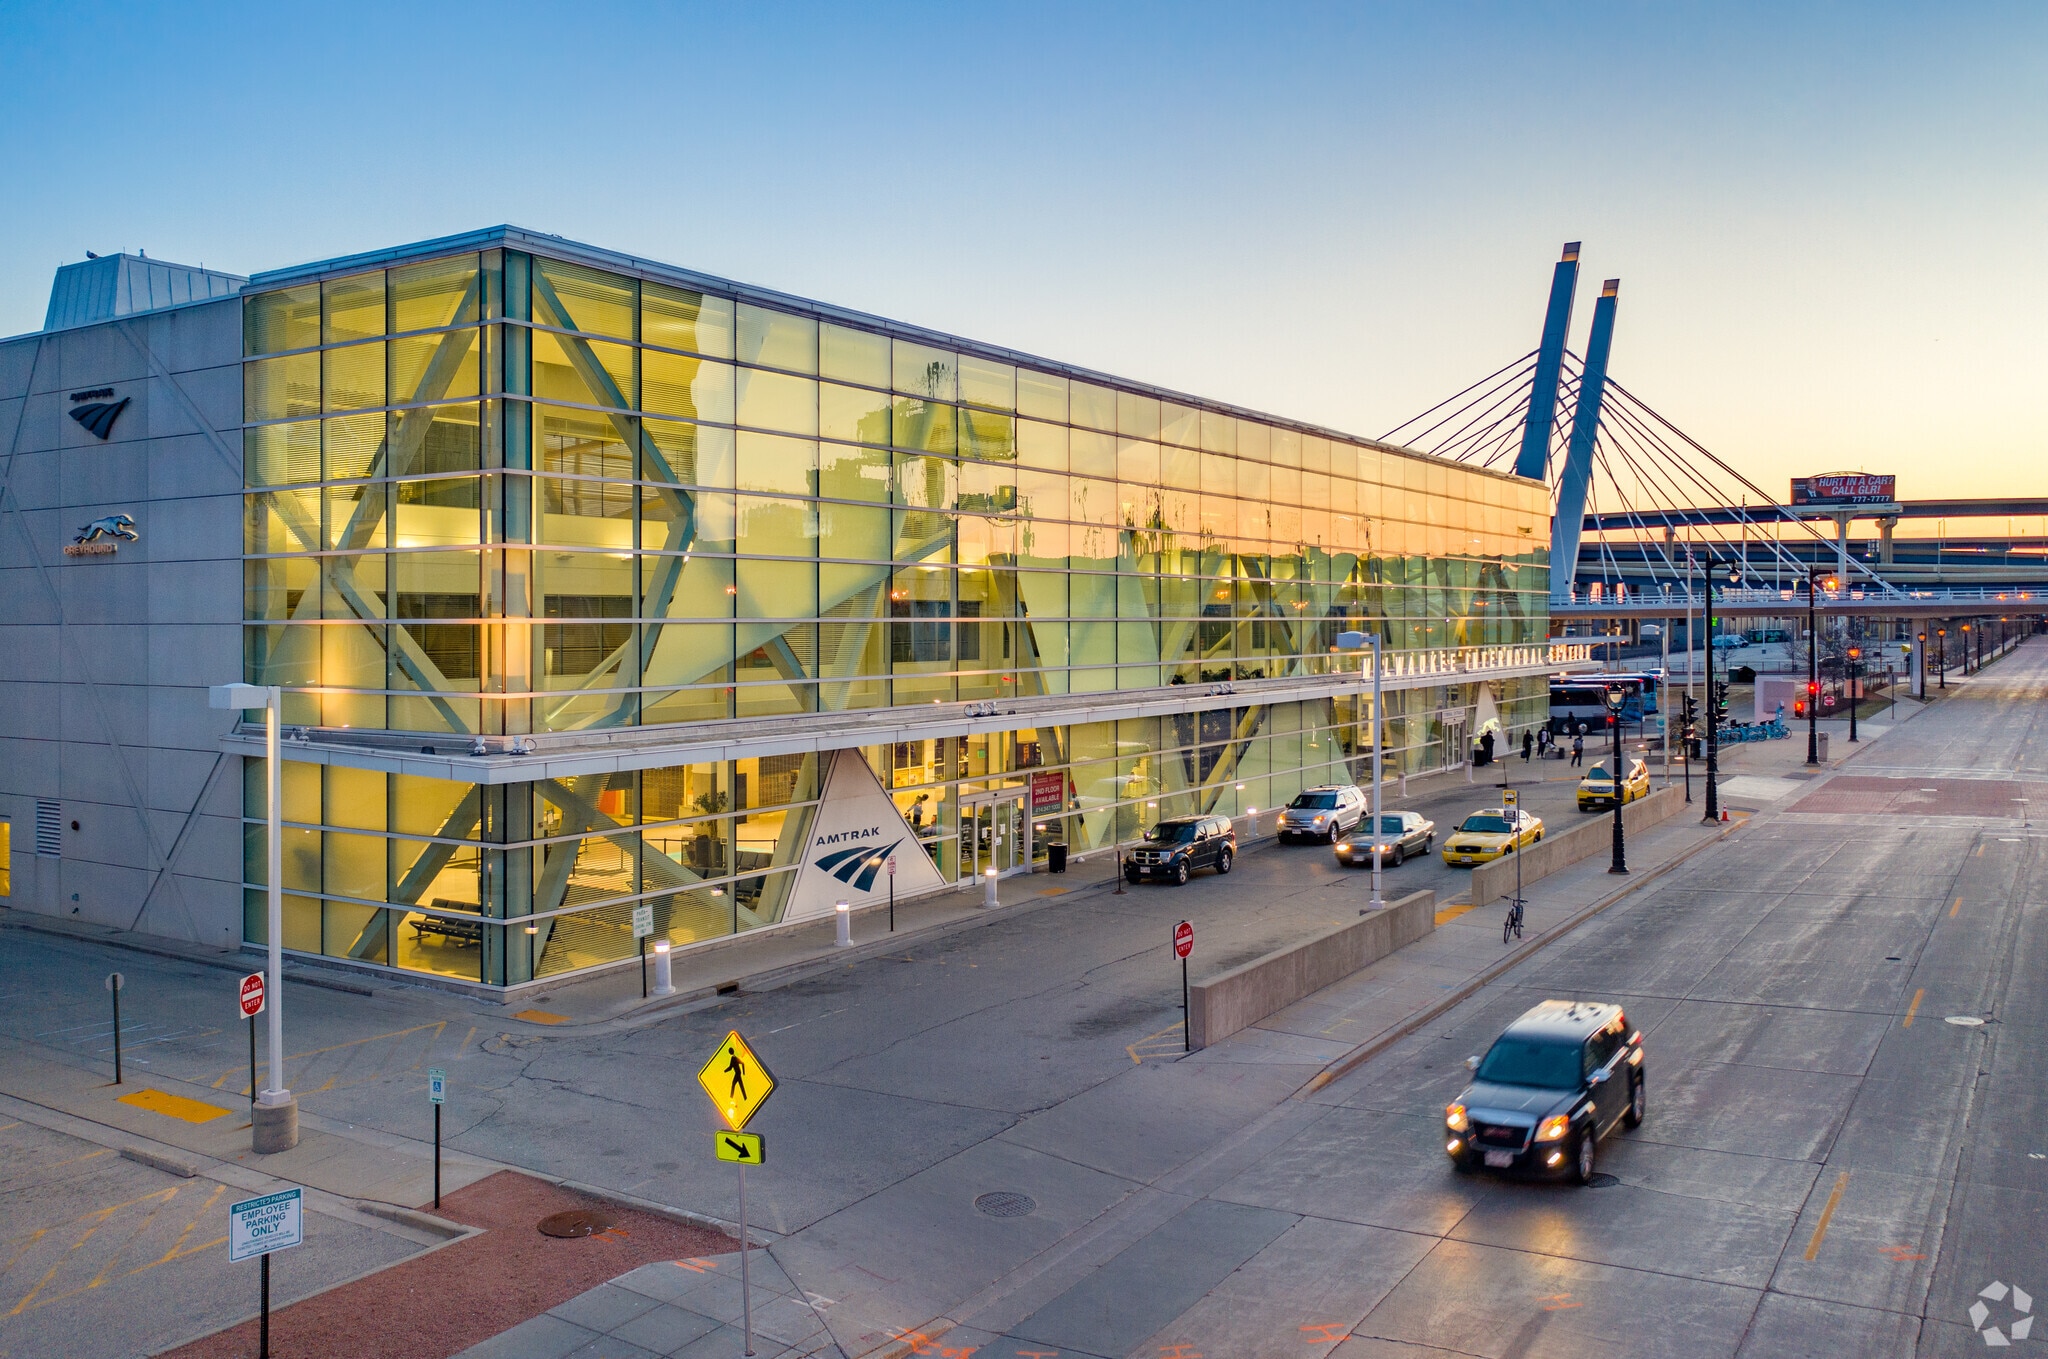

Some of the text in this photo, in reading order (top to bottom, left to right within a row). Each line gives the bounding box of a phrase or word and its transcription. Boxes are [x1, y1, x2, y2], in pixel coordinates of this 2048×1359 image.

[1819, 475, 1894, 487] HURT IN A CAR?
[1831, 485, 1881, 496] CALL GLR!
[1852, 495, 1891, 503] 777-7777
[63, 543, 117, 556] GREYHOUND
[1362, 644, 1591, 678] MLWAUKEE INTERMODAL STATION
[1045, 785, 1059, 793] FLOOR
[1035, 794, 1059, 803] AVAILABLE
[816, 826, 880, 846] AMTRAK
[1178, 943, 1190, 952] ENTER
[252, 981, 260, 989] NOT
[245, 998, 260, 1009] ENTER
[236, 1191, 297, 1212] RESTRICTED PARKING
[241, 1201, 291, 1221] EMPLOYEE
[246, 1212, 286, 1229] PARKING
[251, 1222, 281, 1238] ONLY
